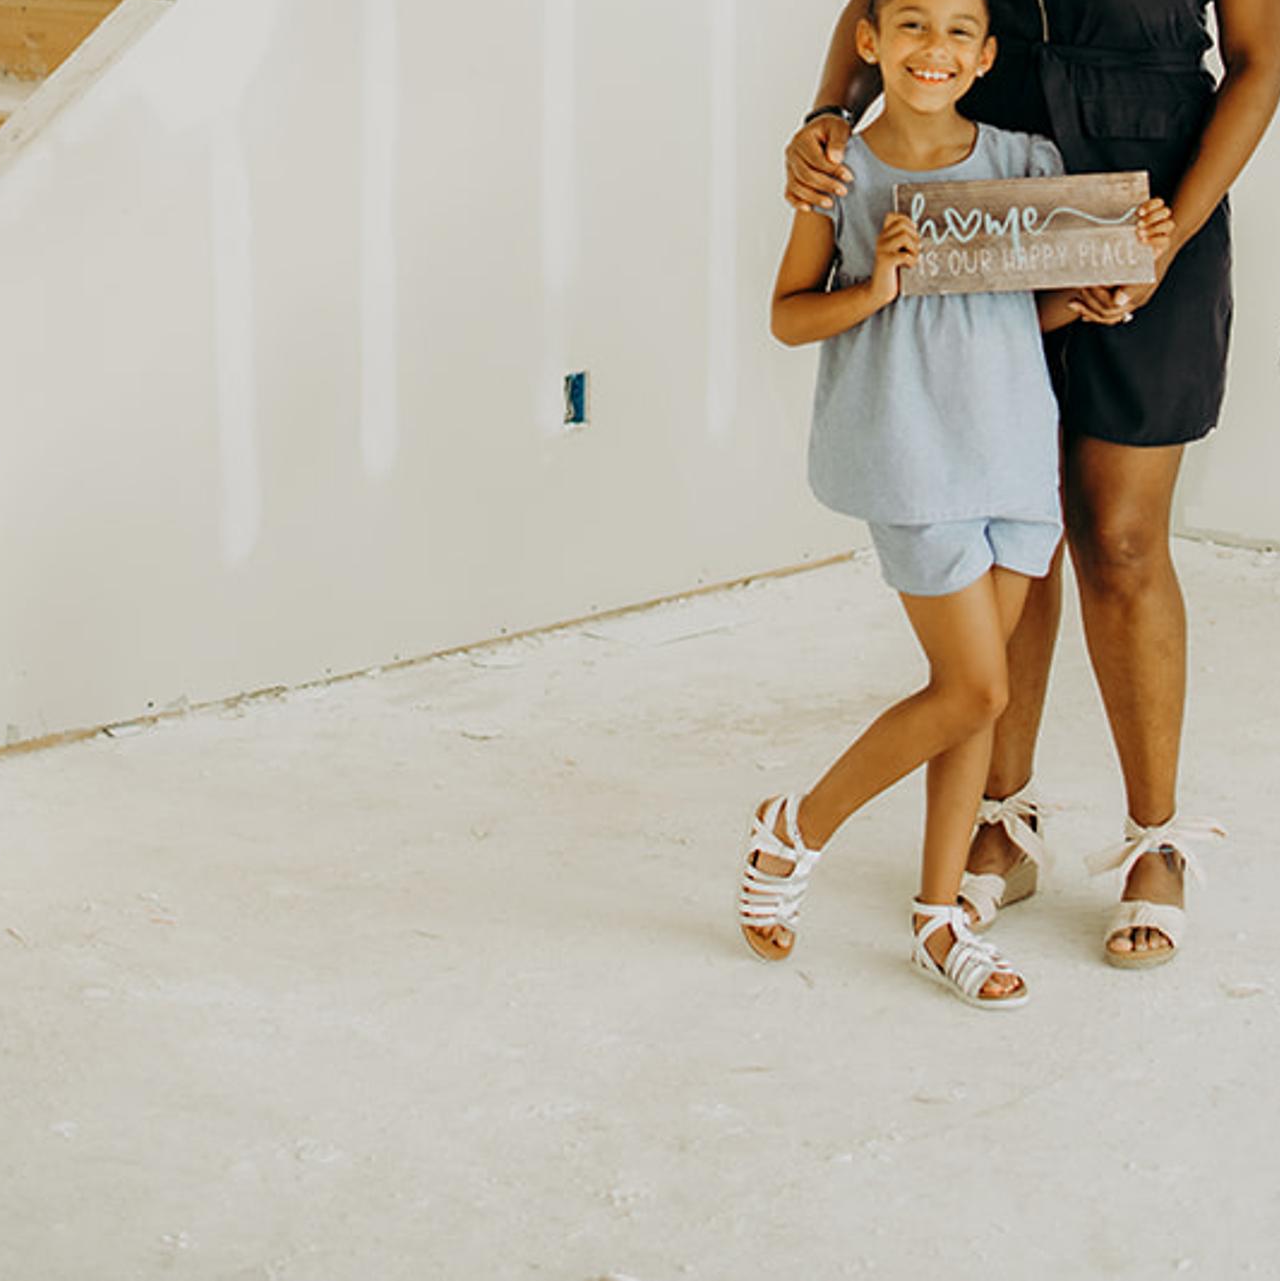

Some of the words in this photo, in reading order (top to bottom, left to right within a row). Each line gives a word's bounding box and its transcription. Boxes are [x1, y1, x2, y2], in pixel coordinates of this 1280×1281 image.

[918, 250, 939, 277] IS
[947, 249, 992, 276] OUR
[1002, 243, 1067, 272] HAPPY
[1077, 238, 1138, 268] PLACE
